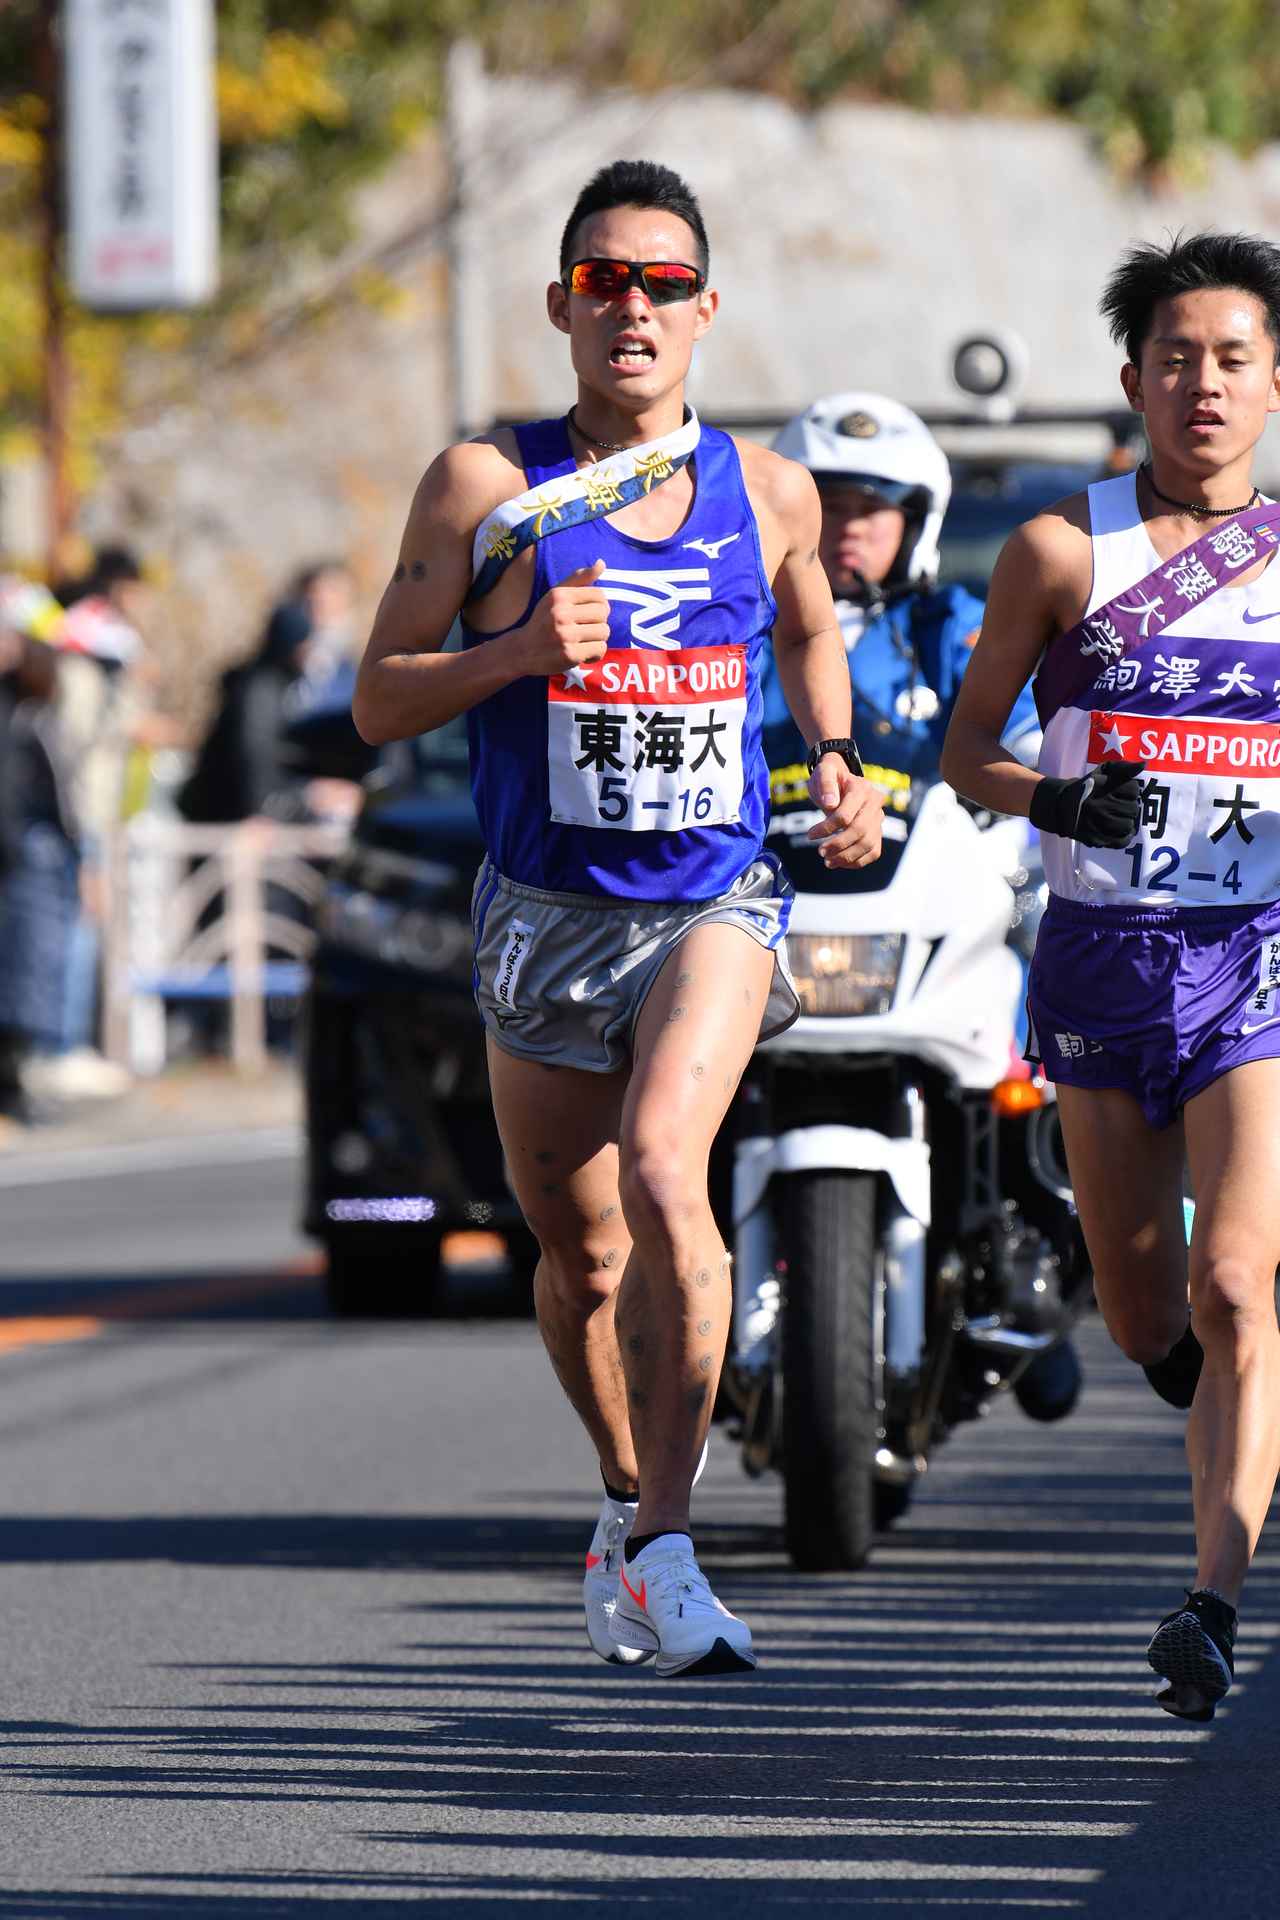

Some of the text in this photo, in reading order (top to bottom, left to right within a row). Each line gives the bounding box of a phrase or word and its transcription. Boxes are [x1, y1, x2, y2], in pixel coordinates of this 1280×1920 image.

[601, 658, 742, 694] SAPPORO
[1093, 654, 1280, 709] 駒澤大
[574, 708, 727, 774] 東海大
